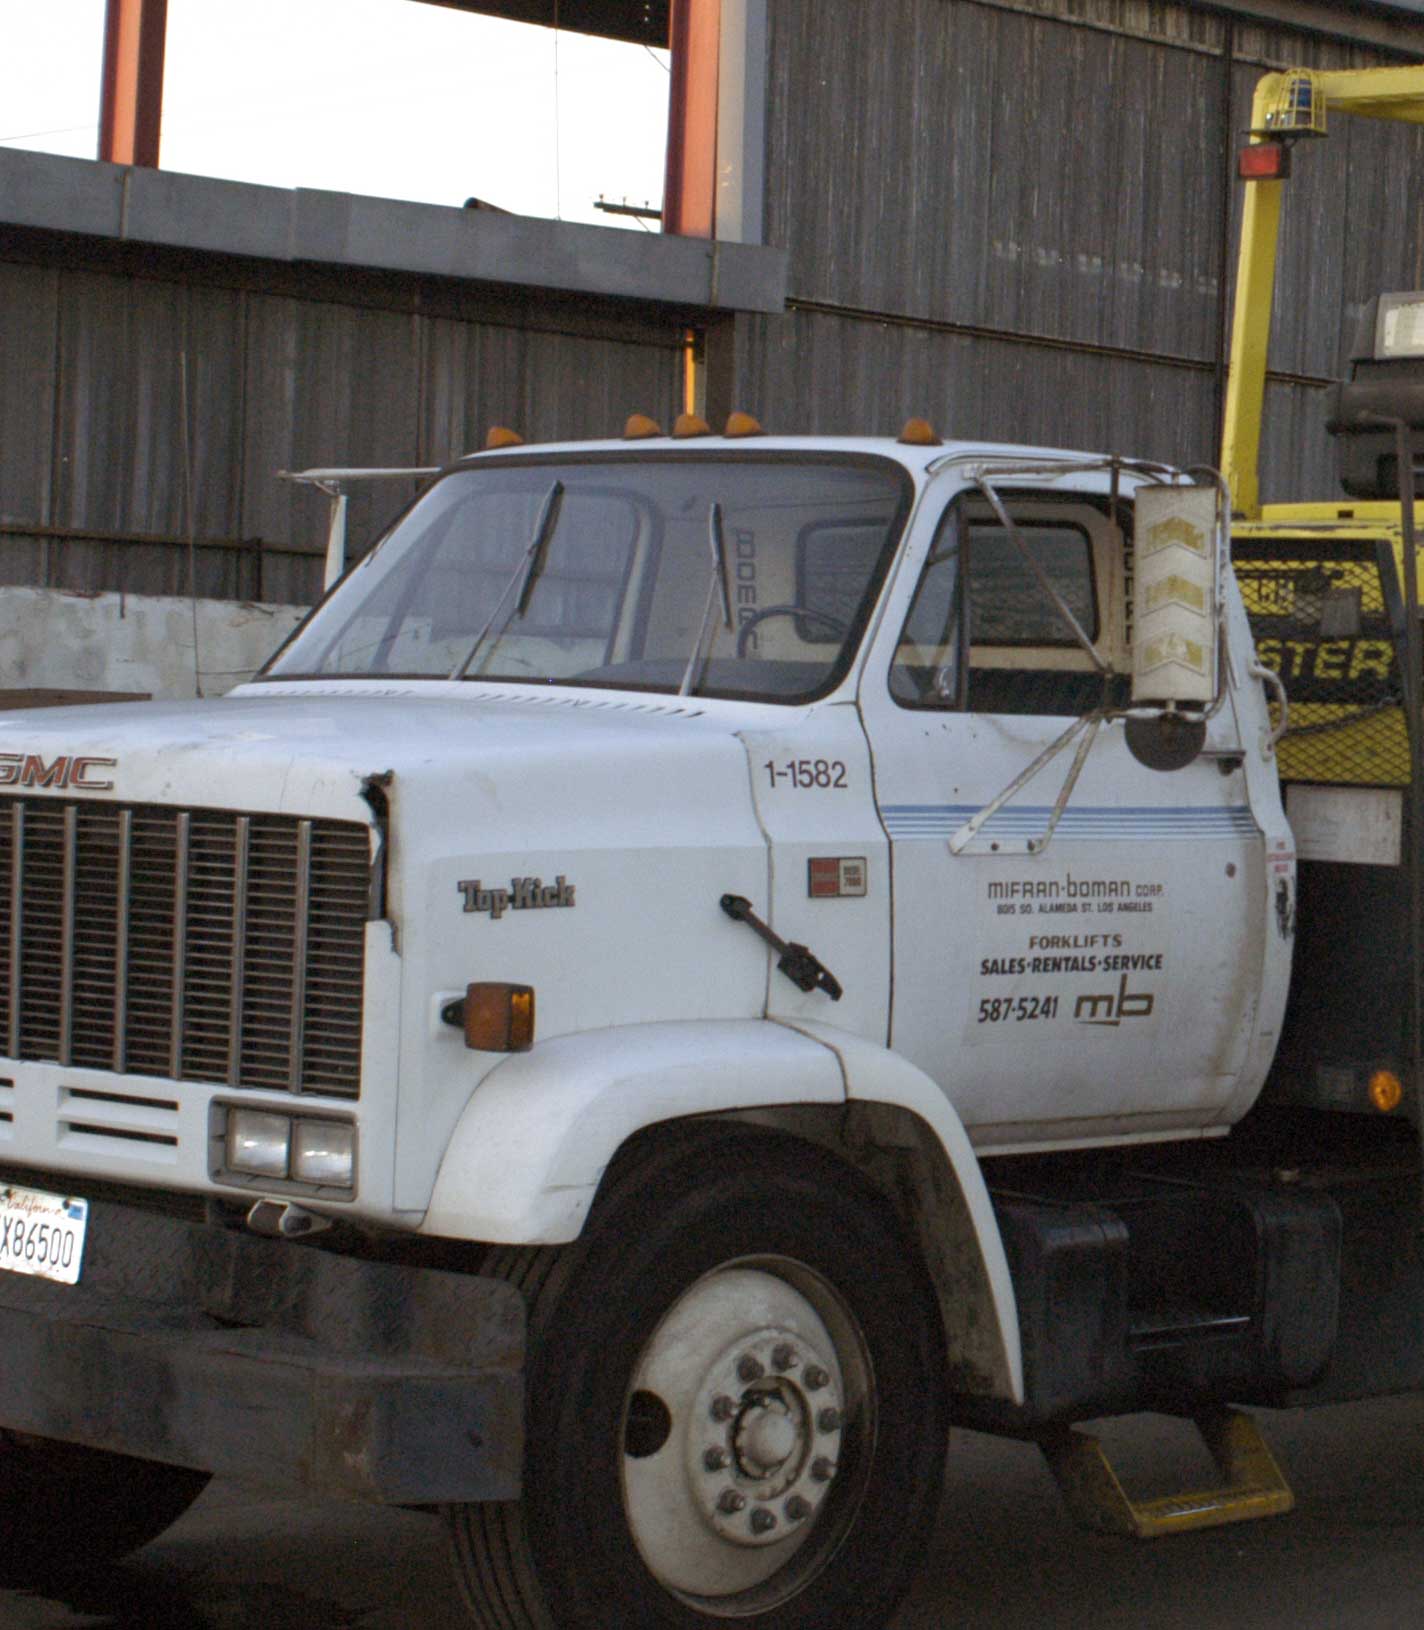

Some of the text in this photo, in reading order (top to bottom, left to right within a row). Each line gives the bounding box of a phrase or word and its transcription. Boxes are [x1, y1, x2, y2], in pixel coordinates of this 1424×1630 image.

[1257, 639, 1394, 680] STER
[764, 759, 848, 788] 1-1582
[1039, 902, 1078, 914] ALAMEDA
[1097, 902, 1114, 913] LOS
[1117, 901, 1153, 913] ANGELES
[1029, 933, 1123, 950] FORKLIFTS
